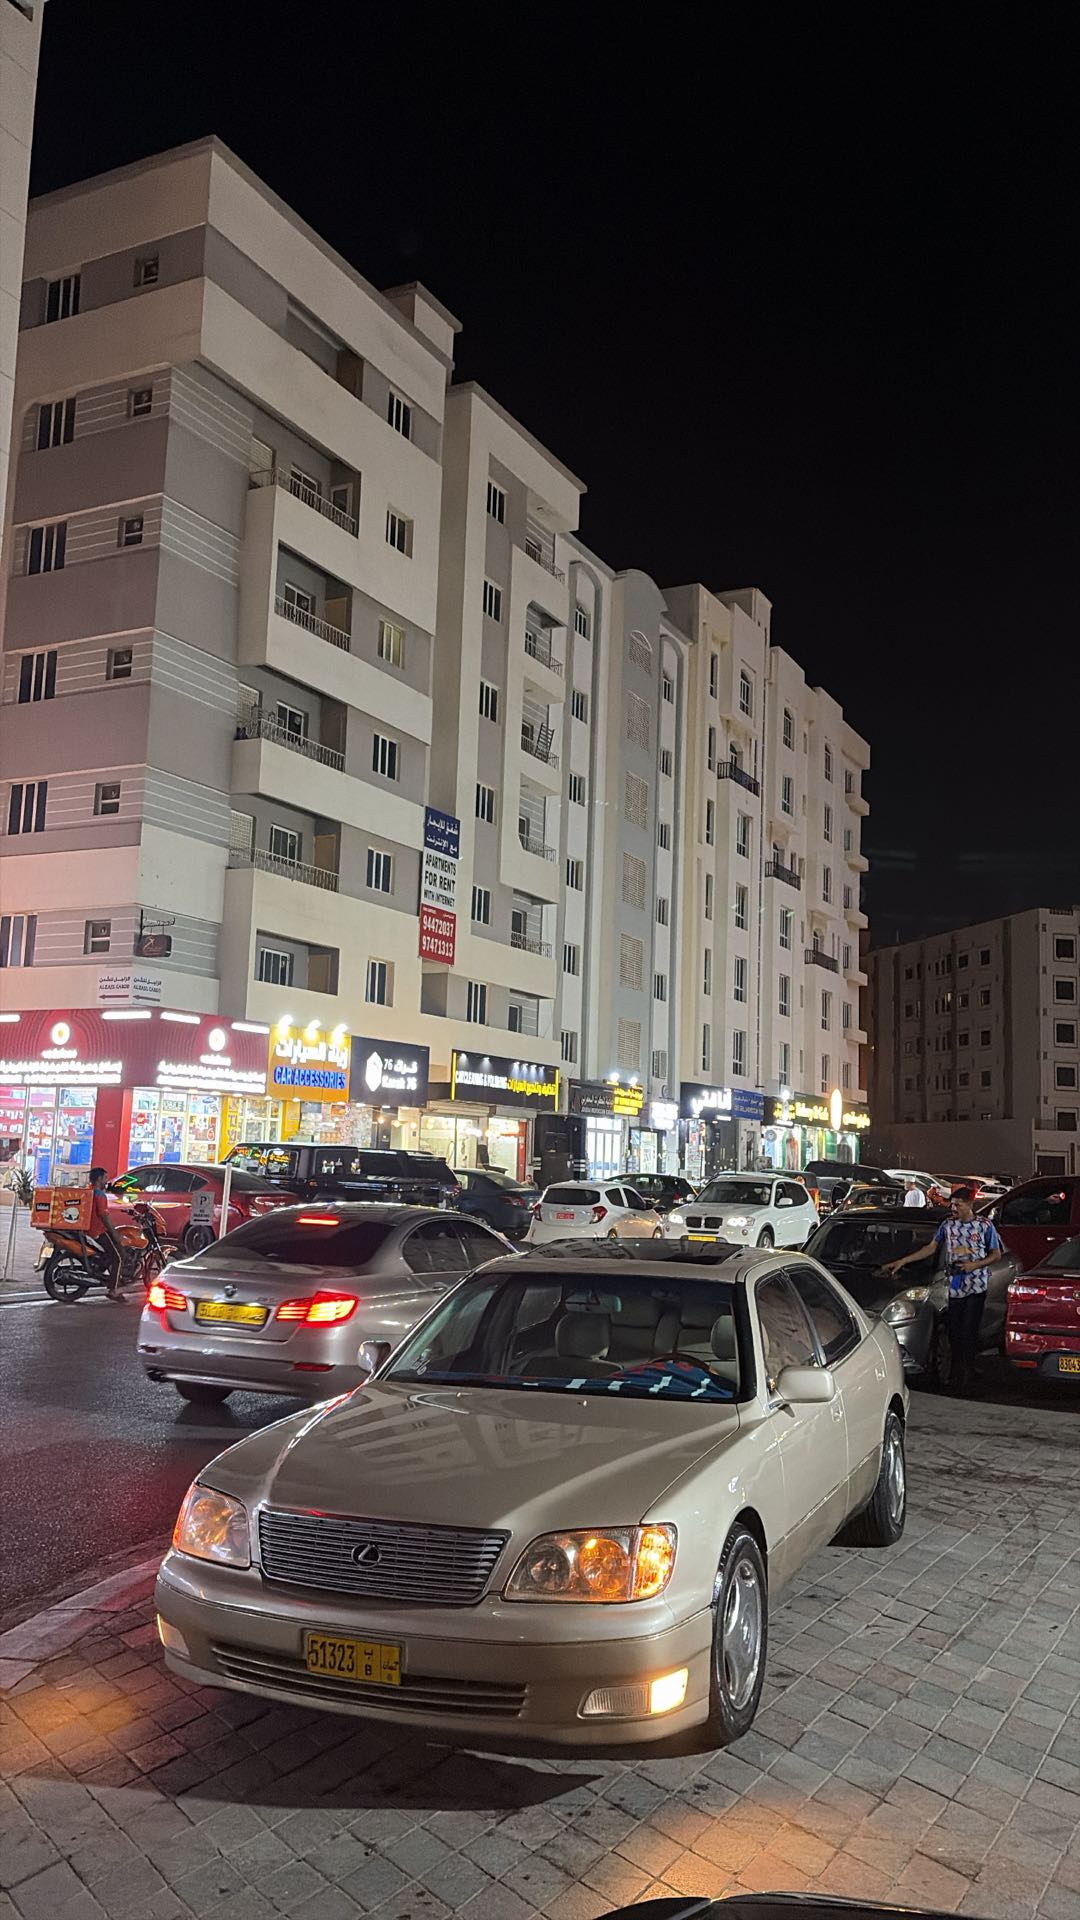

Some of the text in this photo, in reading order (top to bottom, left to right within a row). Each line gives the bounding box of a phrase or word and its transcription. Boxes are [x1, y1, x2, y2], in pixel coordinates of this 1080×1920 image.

[425, 852, 457, 876] APARTMENTS
[424, 870, 456, 894] FOR RENT
[423, 889, 455, 907] WITH INTERNET
[422, 914, 454, 938] 94472037
[421, 935, 454, 958] 97471313
[383, 1058, 393, 1071] 76
[274, 1066, 294, 1086] CAR
[294, 1068, 347, 1090] ACCESSORIES
[200, 1195, 207, 1206] P
[308, 1640, 355, 1673] 51323
[364, 1663, 373, 1676] B
